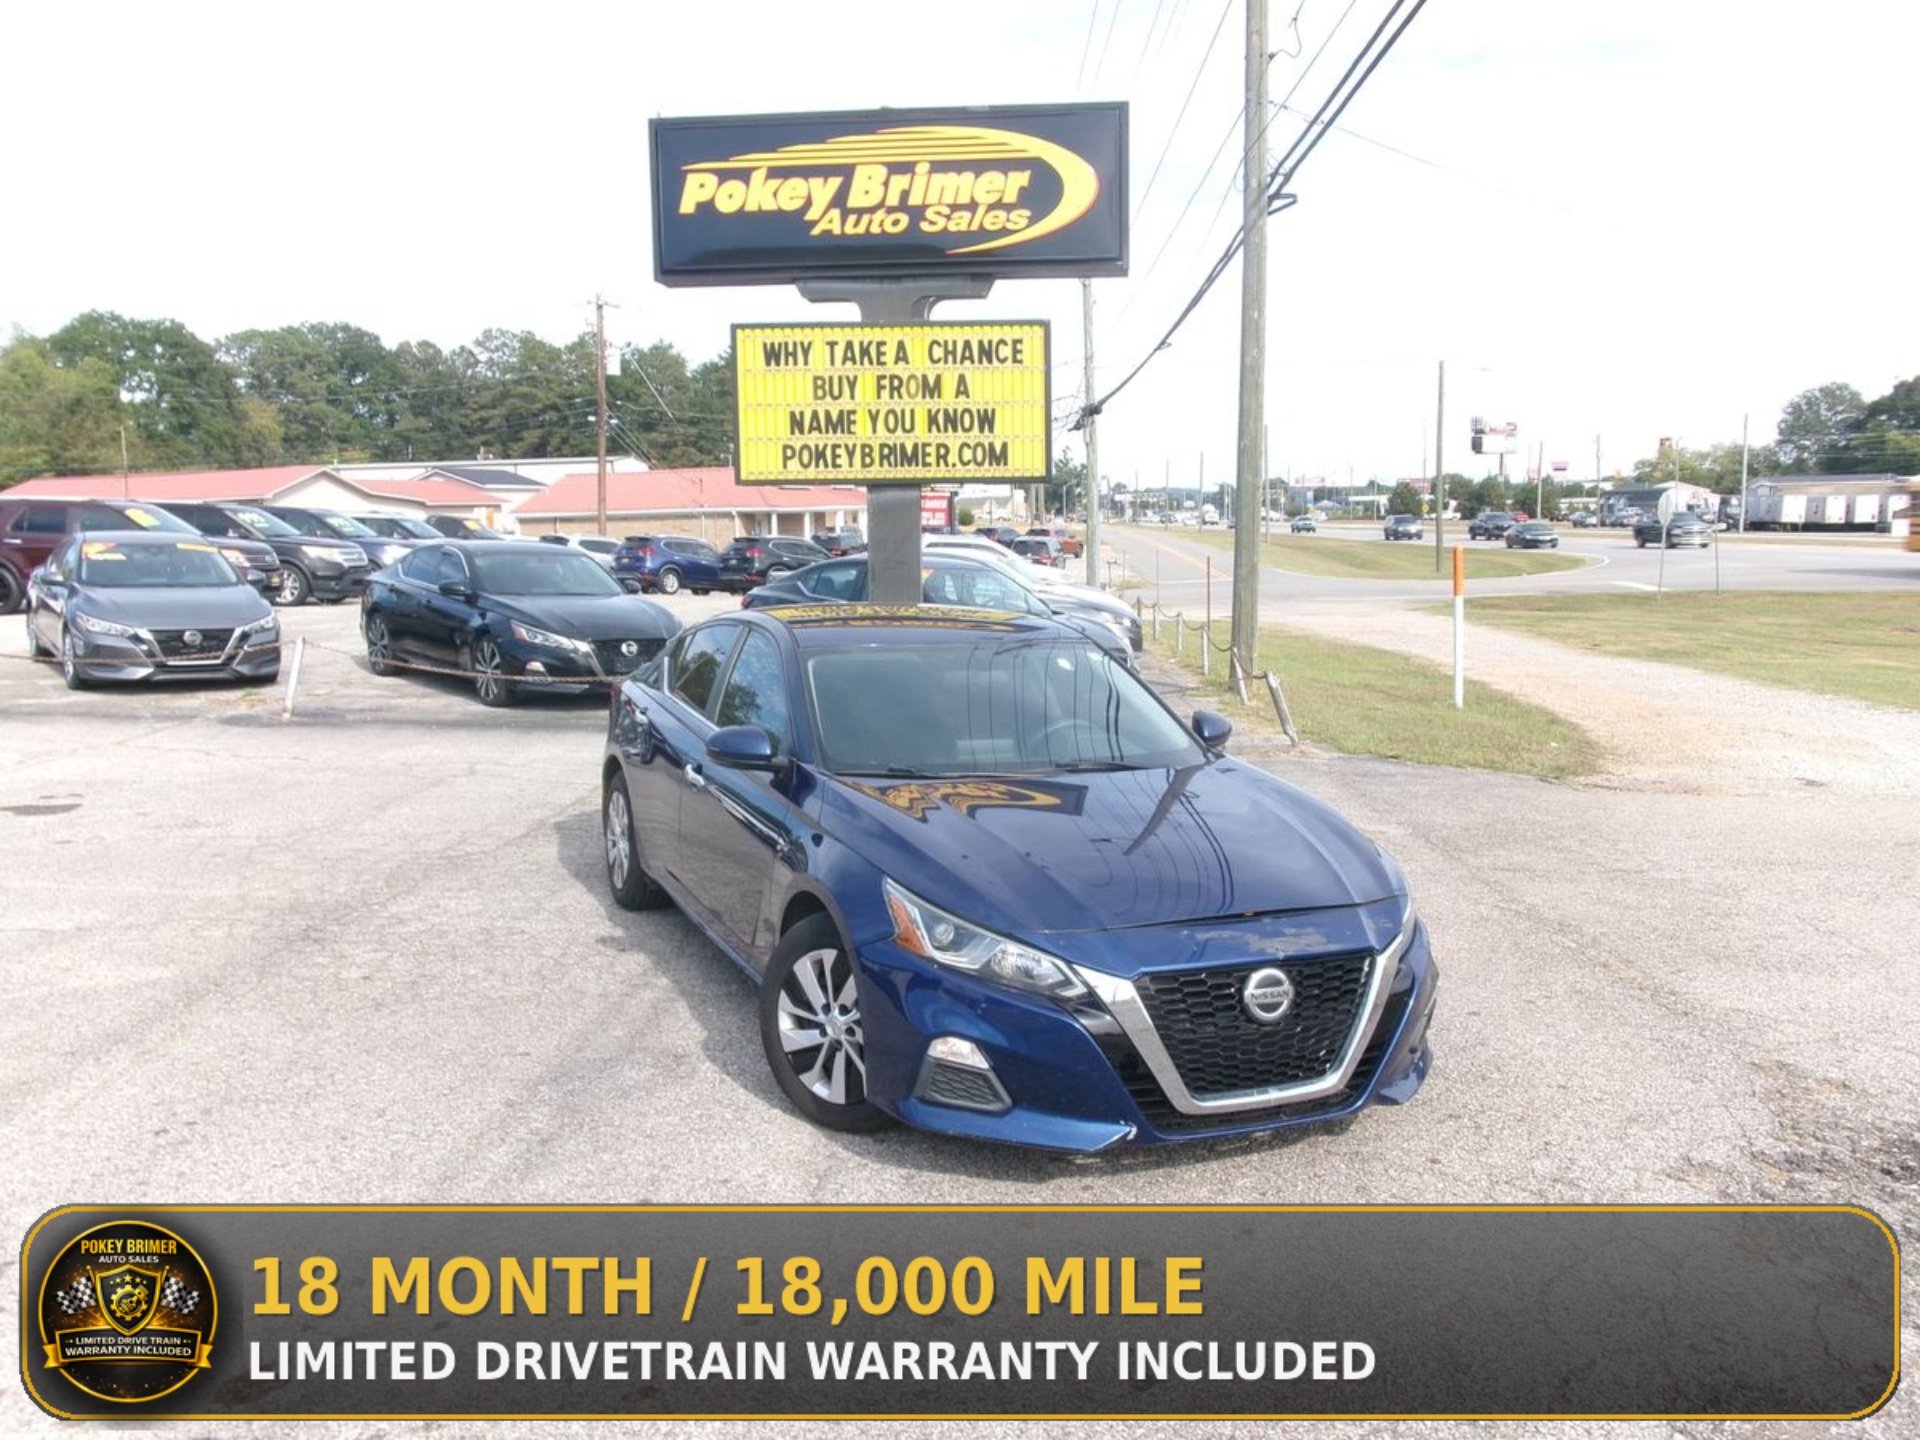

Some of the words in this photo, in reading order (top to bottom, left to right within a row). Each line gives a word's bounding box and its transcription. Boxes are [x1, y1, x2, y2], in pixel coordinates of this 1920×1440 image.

[679, 166, 843, 220] Pokey
[846, 162, 1031, 207] Brimer
[811, 208, 911, 236] Auto
[919, 205, 1031, 233] Sales
[763, 340, 813, 368] WHY
[826, 340, 887, 366] TAKE
[894, 340, 910, 365] A
[927, 338, 1024, 364] CHANCE
[812, 375, 858, 401] BUY
[876, 374, 942, 400] FROM
[955, 374, 971, 399] A
[789, 409, 857, 436] NAME
[868, 408, 915, 434] YOU
[927, 408, 997, 434] KNOW
[782, 442, 1009, 470] POKEYBRIMER.COM
[1250, 990, 1289, 1001] NISSAN
